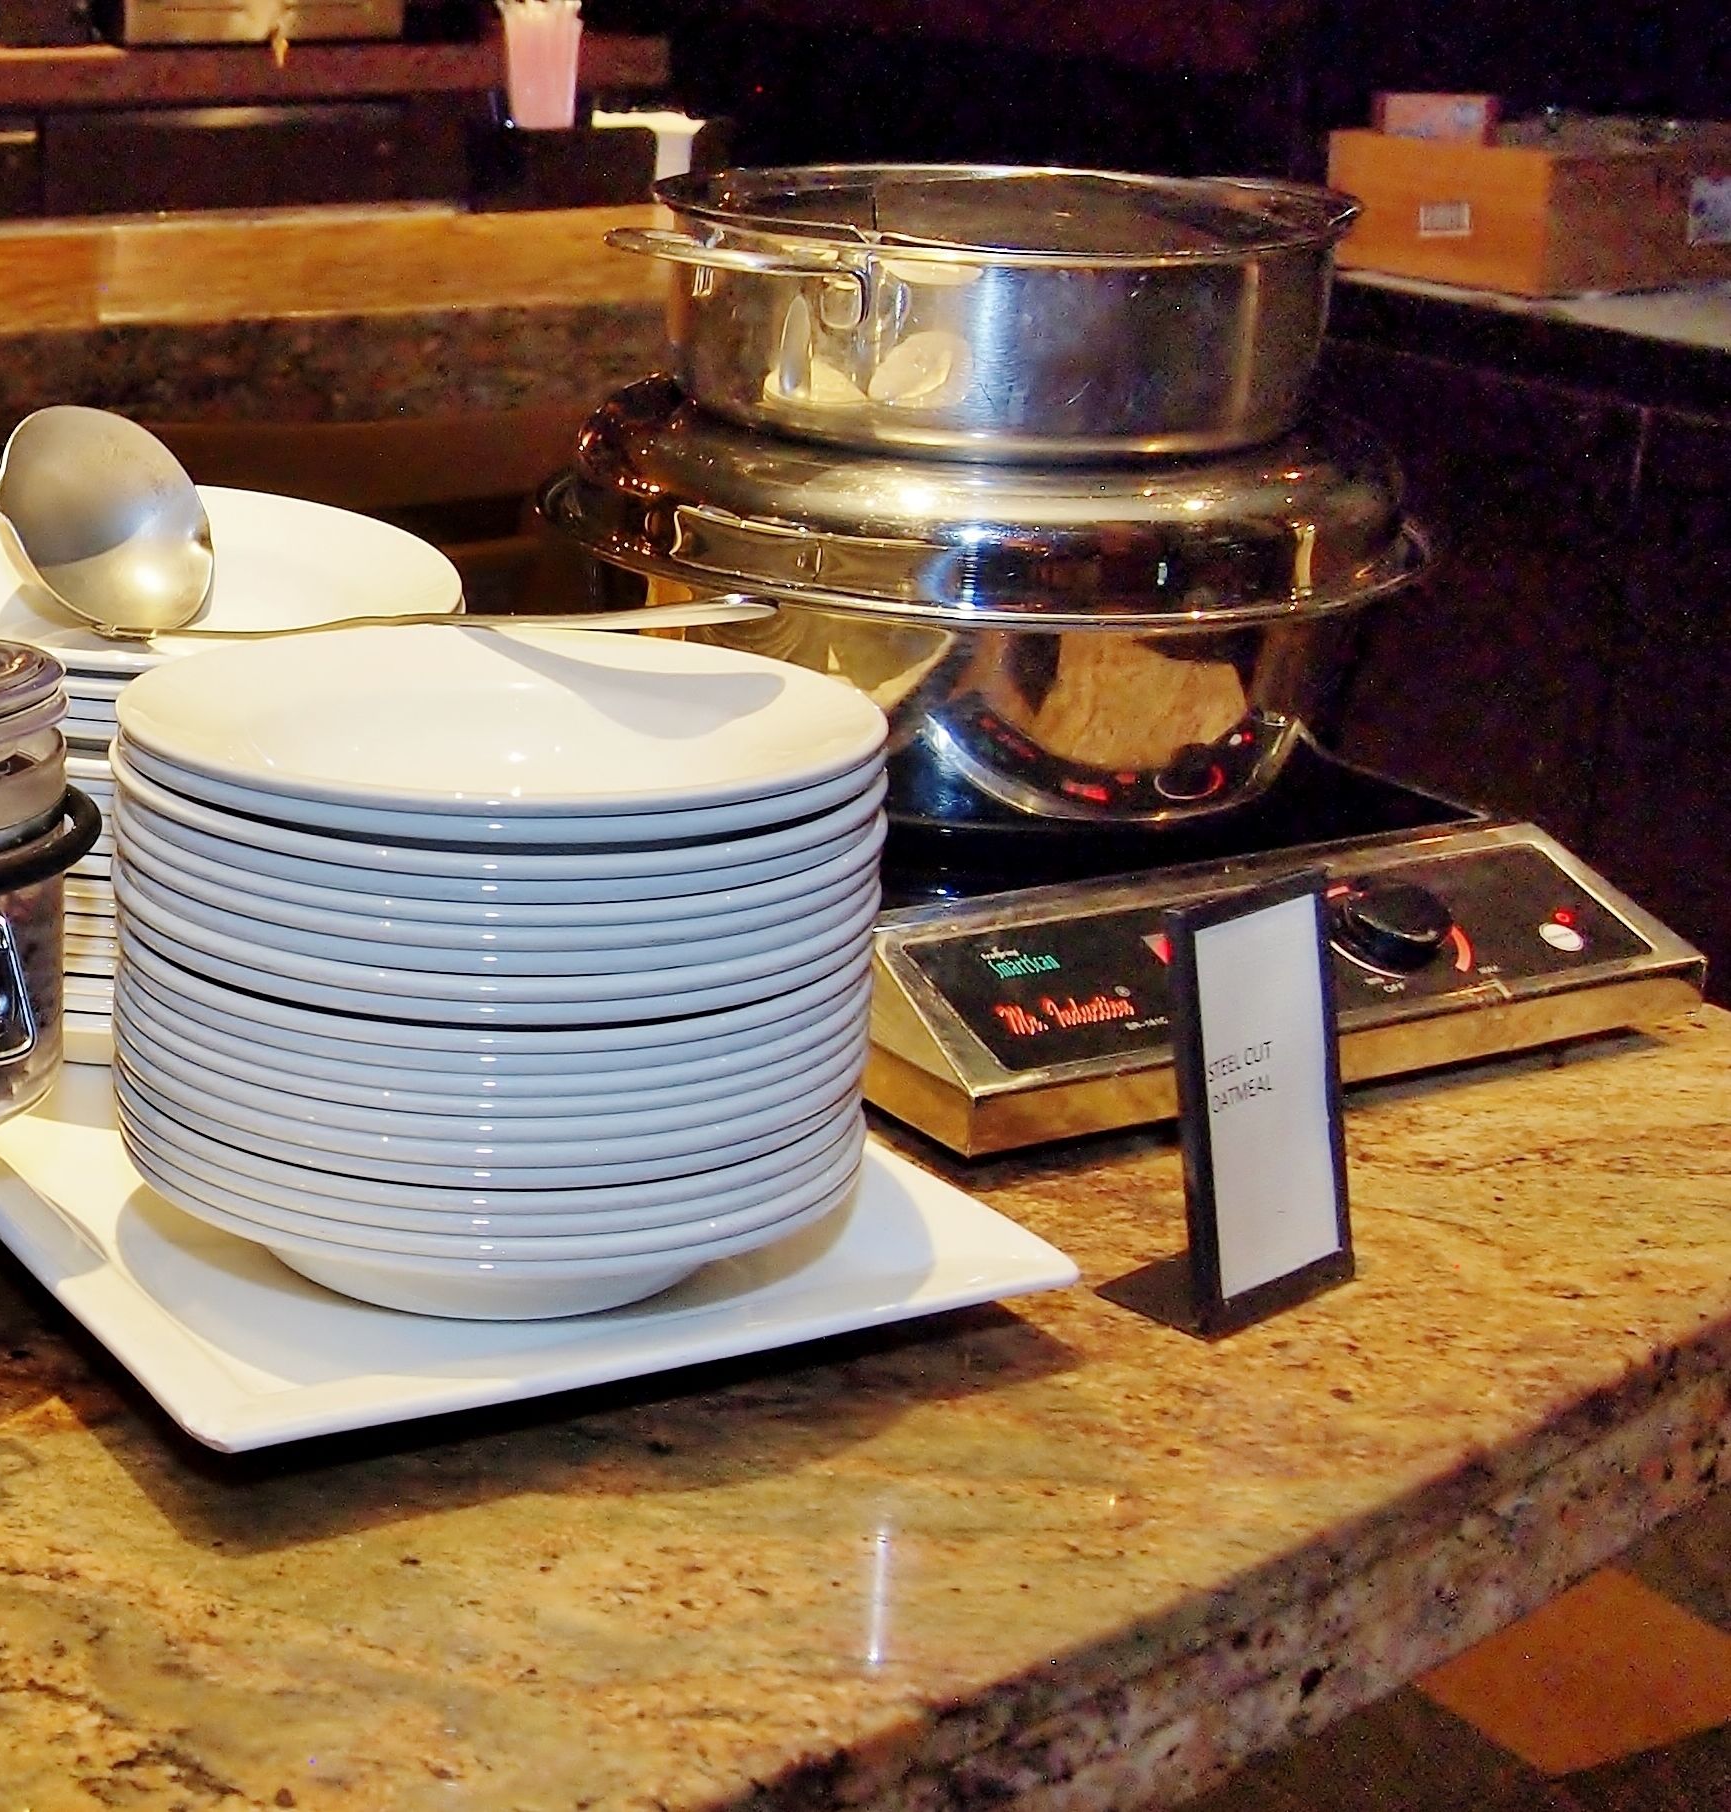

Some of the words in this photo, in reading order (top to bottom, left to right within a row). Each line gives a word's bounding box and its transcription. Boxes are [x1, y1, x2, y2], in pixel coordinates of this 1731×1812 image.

[995, 1004, 1049, 1036] Mr.
[1208, 1054, 1242, 1083] STEEL
[1243, 1040, 1273, 1066] CUT
[1211, 1074, 1273, 1114] OATMEAL
